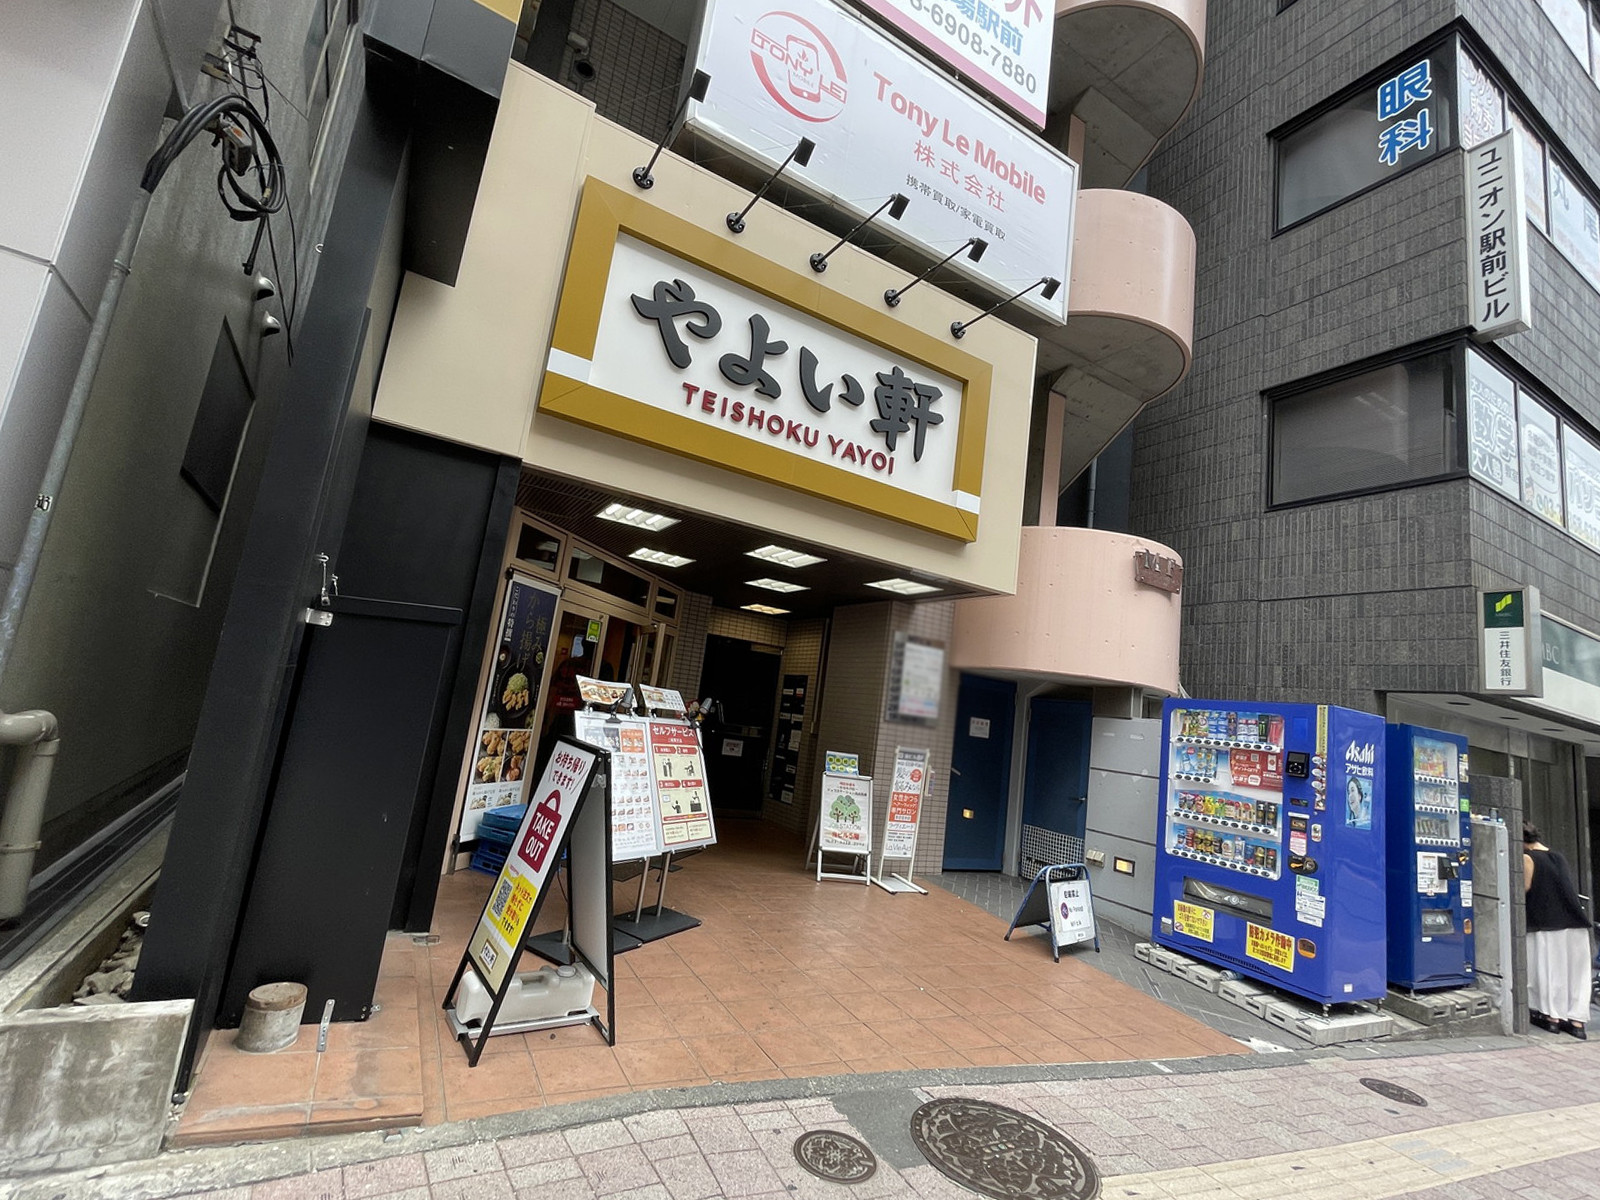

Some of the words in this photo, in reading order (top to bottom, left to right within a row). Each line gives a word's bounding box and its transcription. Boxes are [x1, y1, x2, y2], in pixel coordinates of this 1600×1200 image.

[873, 71, 938, 138] Tony
[943, 119, 969, 157] Le
[973, 140, 1046, 206] Mobile
[1378, 59, 1432, 166] 眼科
[913, 139, 1006, 213] 株式会社
[905, 174, 1007, 242] 携帯買取/家電買取
[1477, 147, 1511, 323] ユニオン駅前ビル
[631, 279, 944, 462] やよい軒
[682, 382, 820, 448] TEISHOKU
[828, 434, 895, 475] YAYOI
[1499, 631, 1511, 686] 三井住友銀行
[653, 725, 695, 738] セルフサービス
[1345, 740, 1375, 764] Asahi
[556, 752, 585, 775] お持ち帰り
[1345, 763, 1374, 777] アサヒ飲料
[525, 838, 545, 862] OUT
[533, 811, 555, 838] TAKE
[1249, 924, 1293, 951] 防犯カメラ作動中
